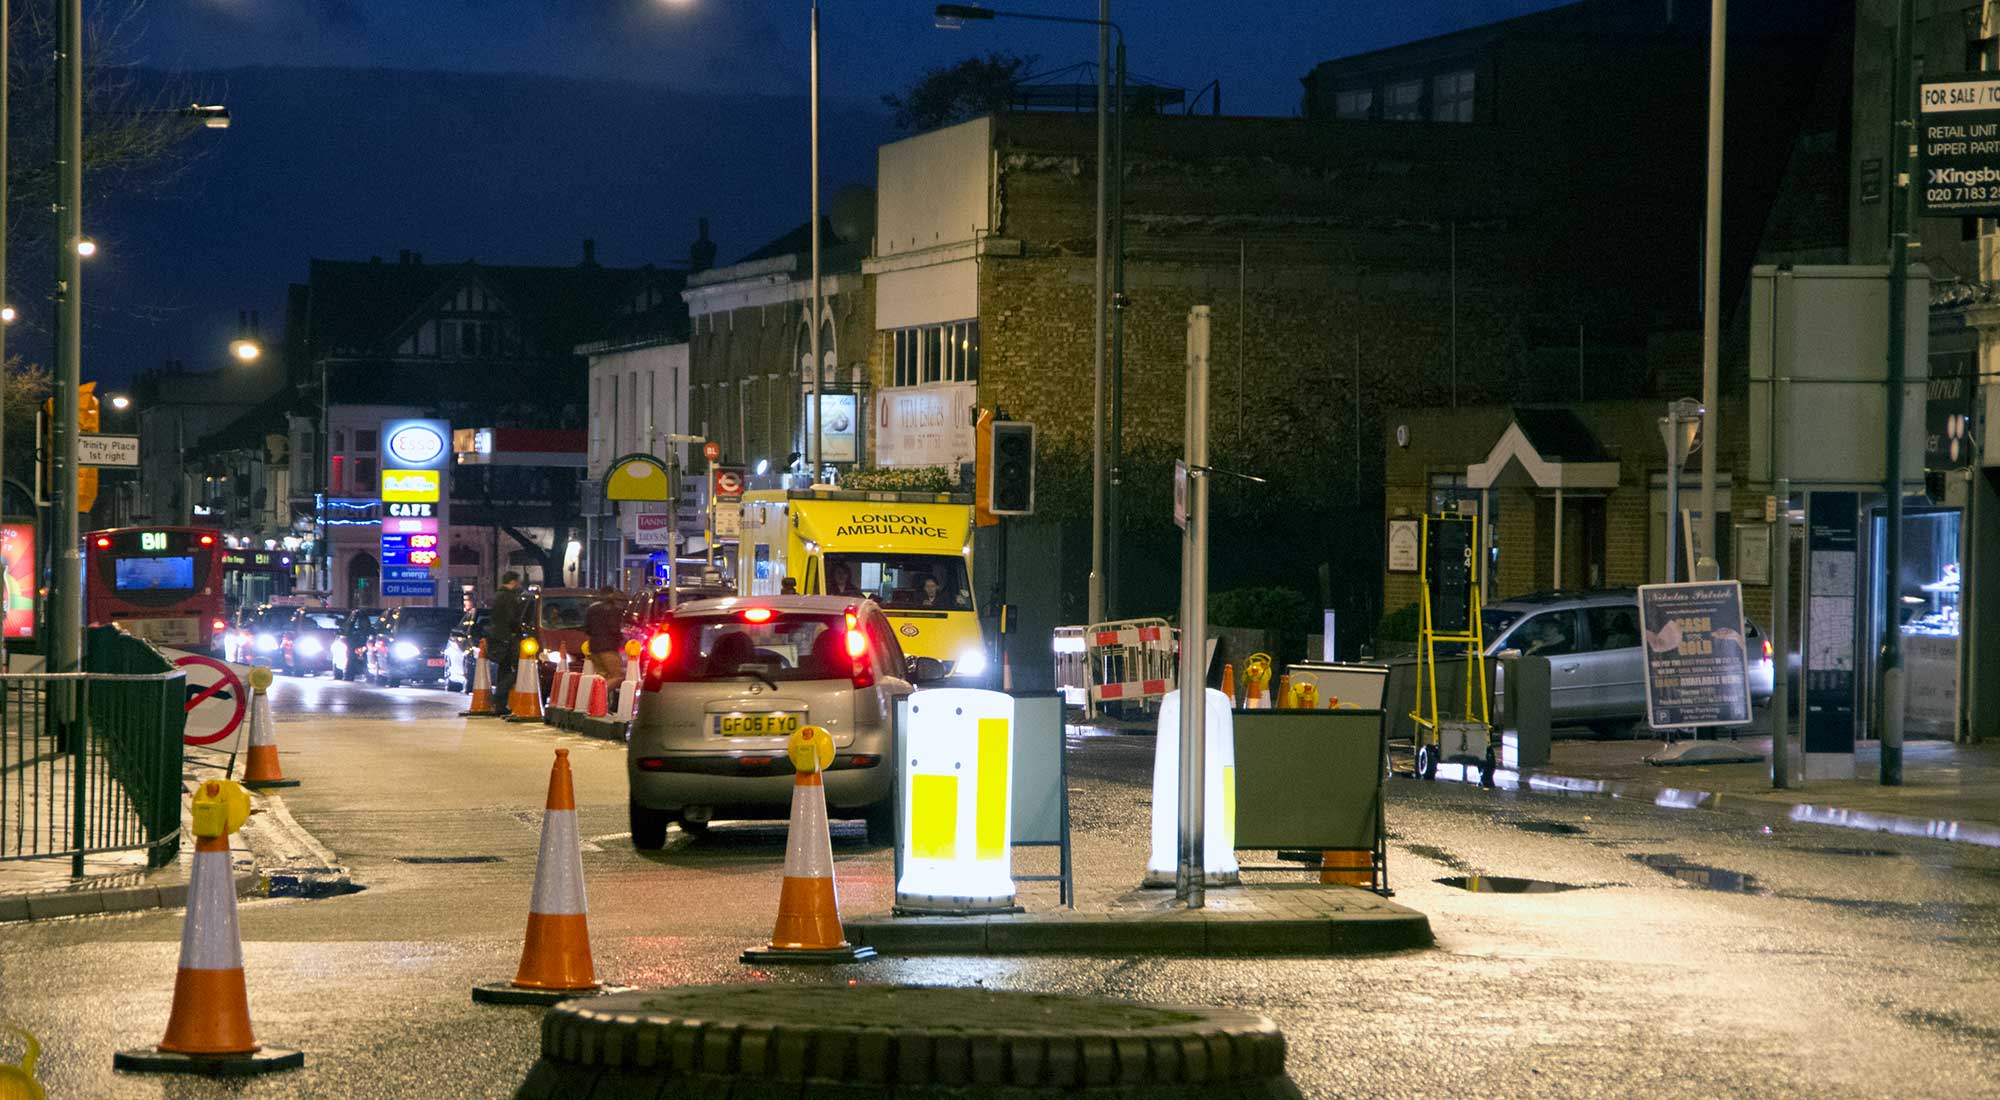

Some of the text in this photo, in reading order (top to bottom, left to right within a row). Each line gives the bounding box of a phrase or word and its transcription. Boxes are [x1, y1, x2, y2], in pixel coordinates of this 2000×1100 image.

[1925, 88, 1947, 105] FOR
[1950, 87, 1976, 104] SALE
[1988, 86, 2000, 102] TO
[1928, 123, 1998, 139] RETAIL UNIT
[1928, 142, 1967, 156] UPPER
[1927, 188, 1952, 201] 020
[1955, 187, 1986, 200] 7183
[83, 440, 136, 451] Trinity Place
[89, 451, 126, 462] 1st right
[389, 503, 432, 517] CAFE
[852, 514, 928, 525] LONDON
[836, 524, 949, 539] AMBULANCE
[141, 532, 167, 550] B11
[1678, 640, 1713, 656] GOLD
[1680, 676, 1720, 686] AVAILABLE
